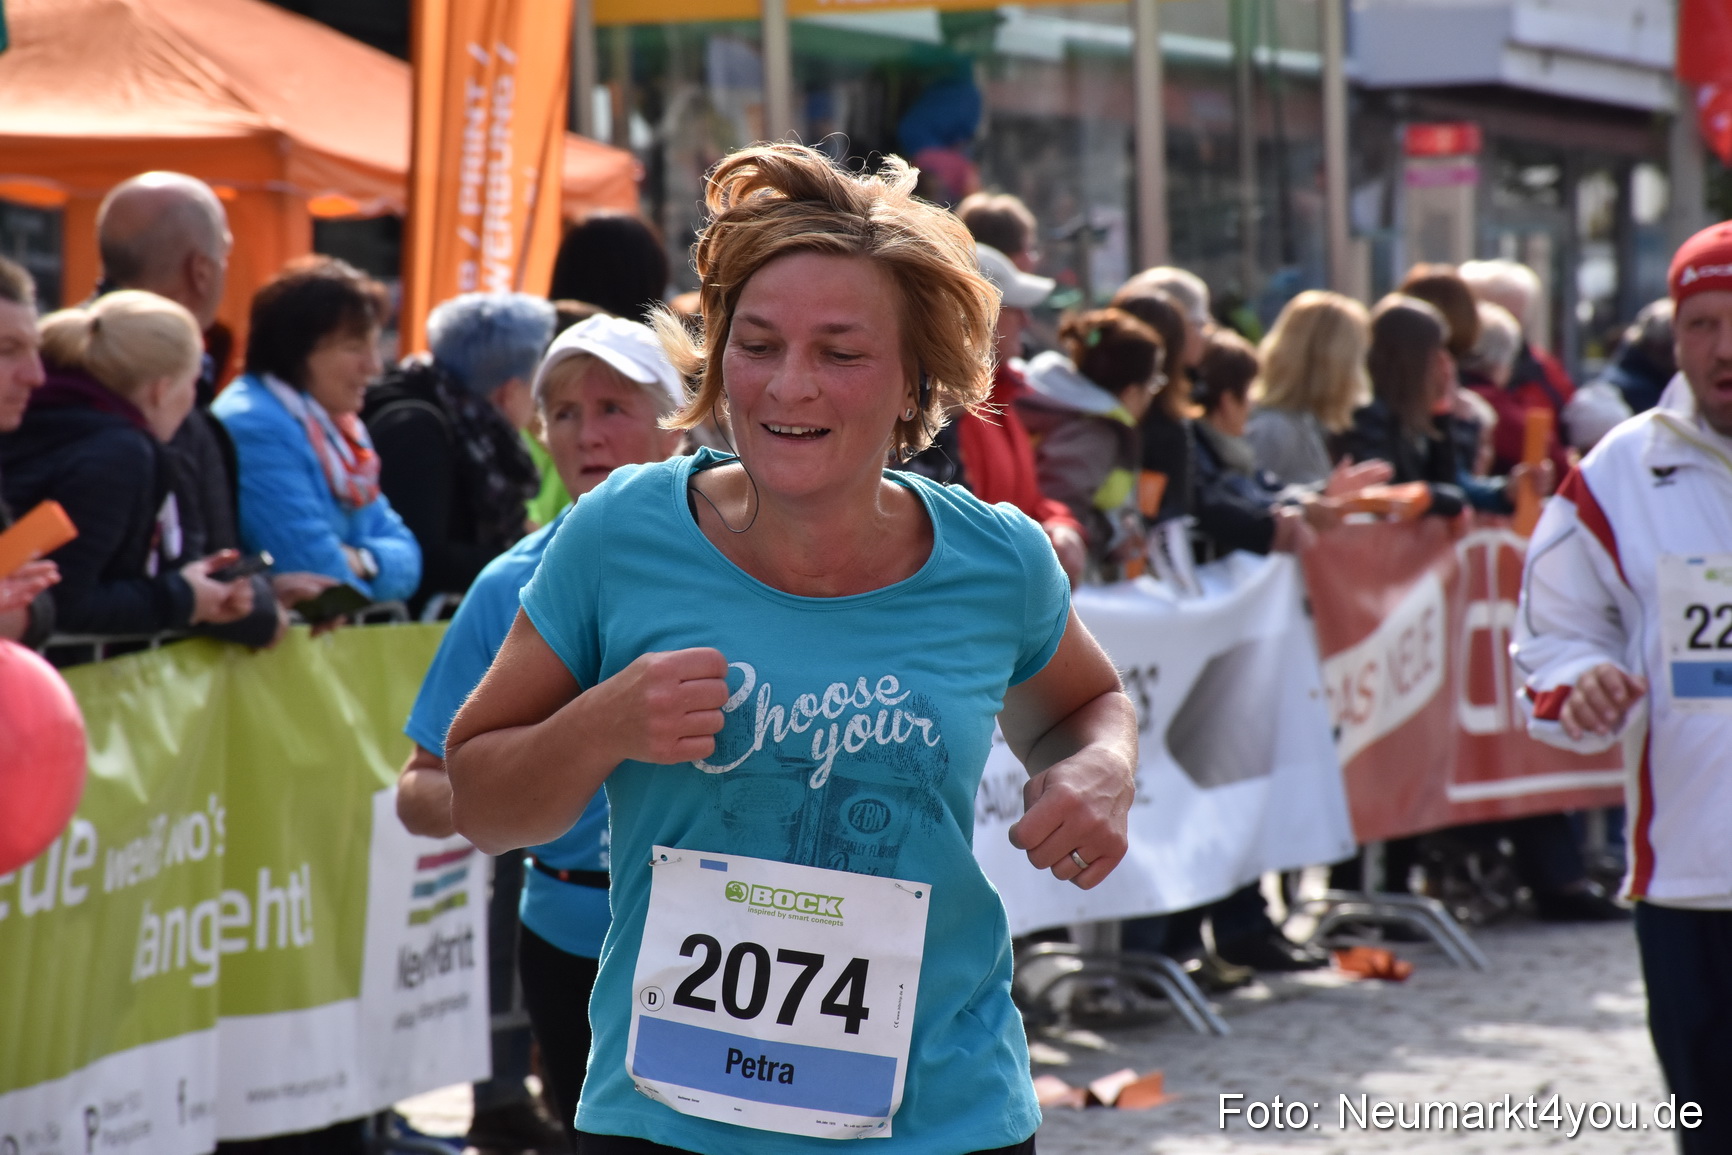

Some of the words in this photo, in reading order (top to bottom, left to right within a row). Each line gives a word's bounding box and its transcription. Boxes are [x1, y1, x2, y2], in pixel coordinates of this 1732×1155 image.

[692, 661, 911, 774] Choose
[811, 708, 941, 789] your
[747, 905, 776, 917] inspired
[777, 911, 787, 920] by
[788, 913, 810, 922] smart
[811, 916, 844, 927] concepts
[749, 884, 845, 919] BOCK
[648, 992, 657, 1005] D
[672, 933, 869, 1035] 2074
[725, 1047, 795, 1085] Petra
